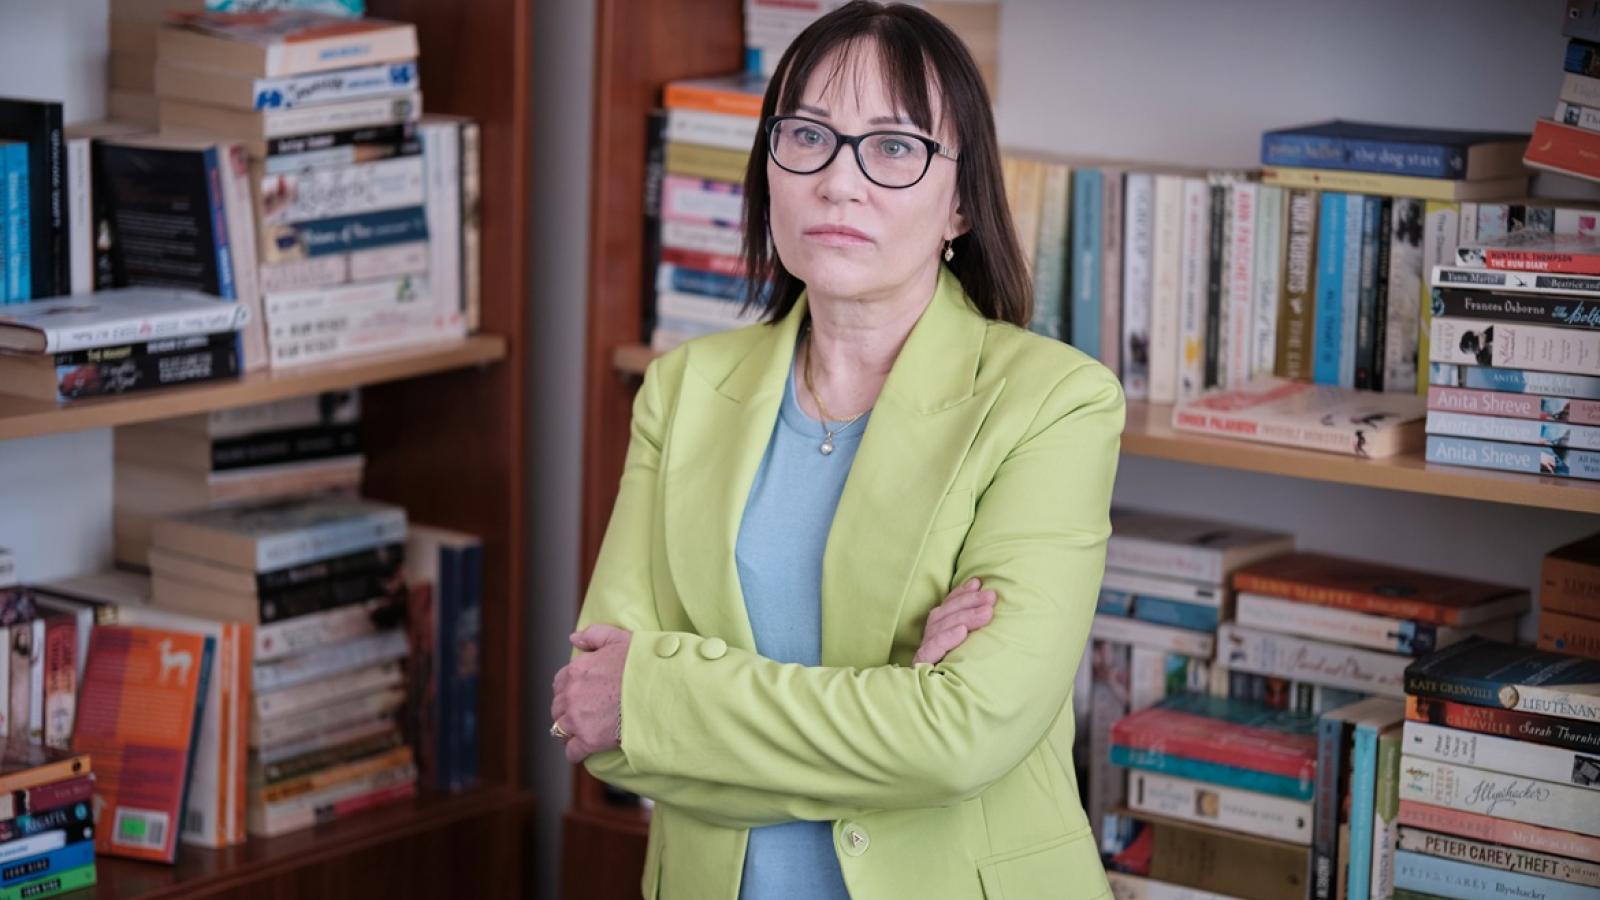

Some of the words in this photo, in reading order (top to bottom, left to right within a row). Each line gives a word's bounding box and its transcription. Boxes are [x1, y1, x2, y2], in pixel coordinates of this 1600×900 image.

[1354, 145, 1376, 162] the
[1379, 148, 1405, 169] dog
[1407, 150, 1442, 168] stars
[1491, 259, 1507, 268] THE
[1508, 261, 1524, 269] RUM
[1525, 262, 1548, 271] DIARY
[1531, 253, 1573, 263] THOMPSON
[1471, 273, 1499, 284] Martel
[1551, 279, 1584, 289] Beatrice
[1465, 297, 1502, 312] Frances
[1504, 300, 1545, 315] Osborne
[1493, 374, 1519, 385] ANITA
[1437, 390, 1478, 409] Anita
[1481, 393, 1531, 415] Shreve
[1435, 441, 1477, 461] Anita
[1480, 444, 1531, 467] Shreve
[1409, 679, 1438, 693] KATE
[1439, 683, 1493, 700] GRENVILLE
[1518, 720, 1552, 737] Sarah
[1425, 835, 1467, 856] PETER
[1516, 853, 1560, 876] THEFT
[1401, 865, 1441, 882] PETER
[1445, 874, 1489, 891] CAREY
